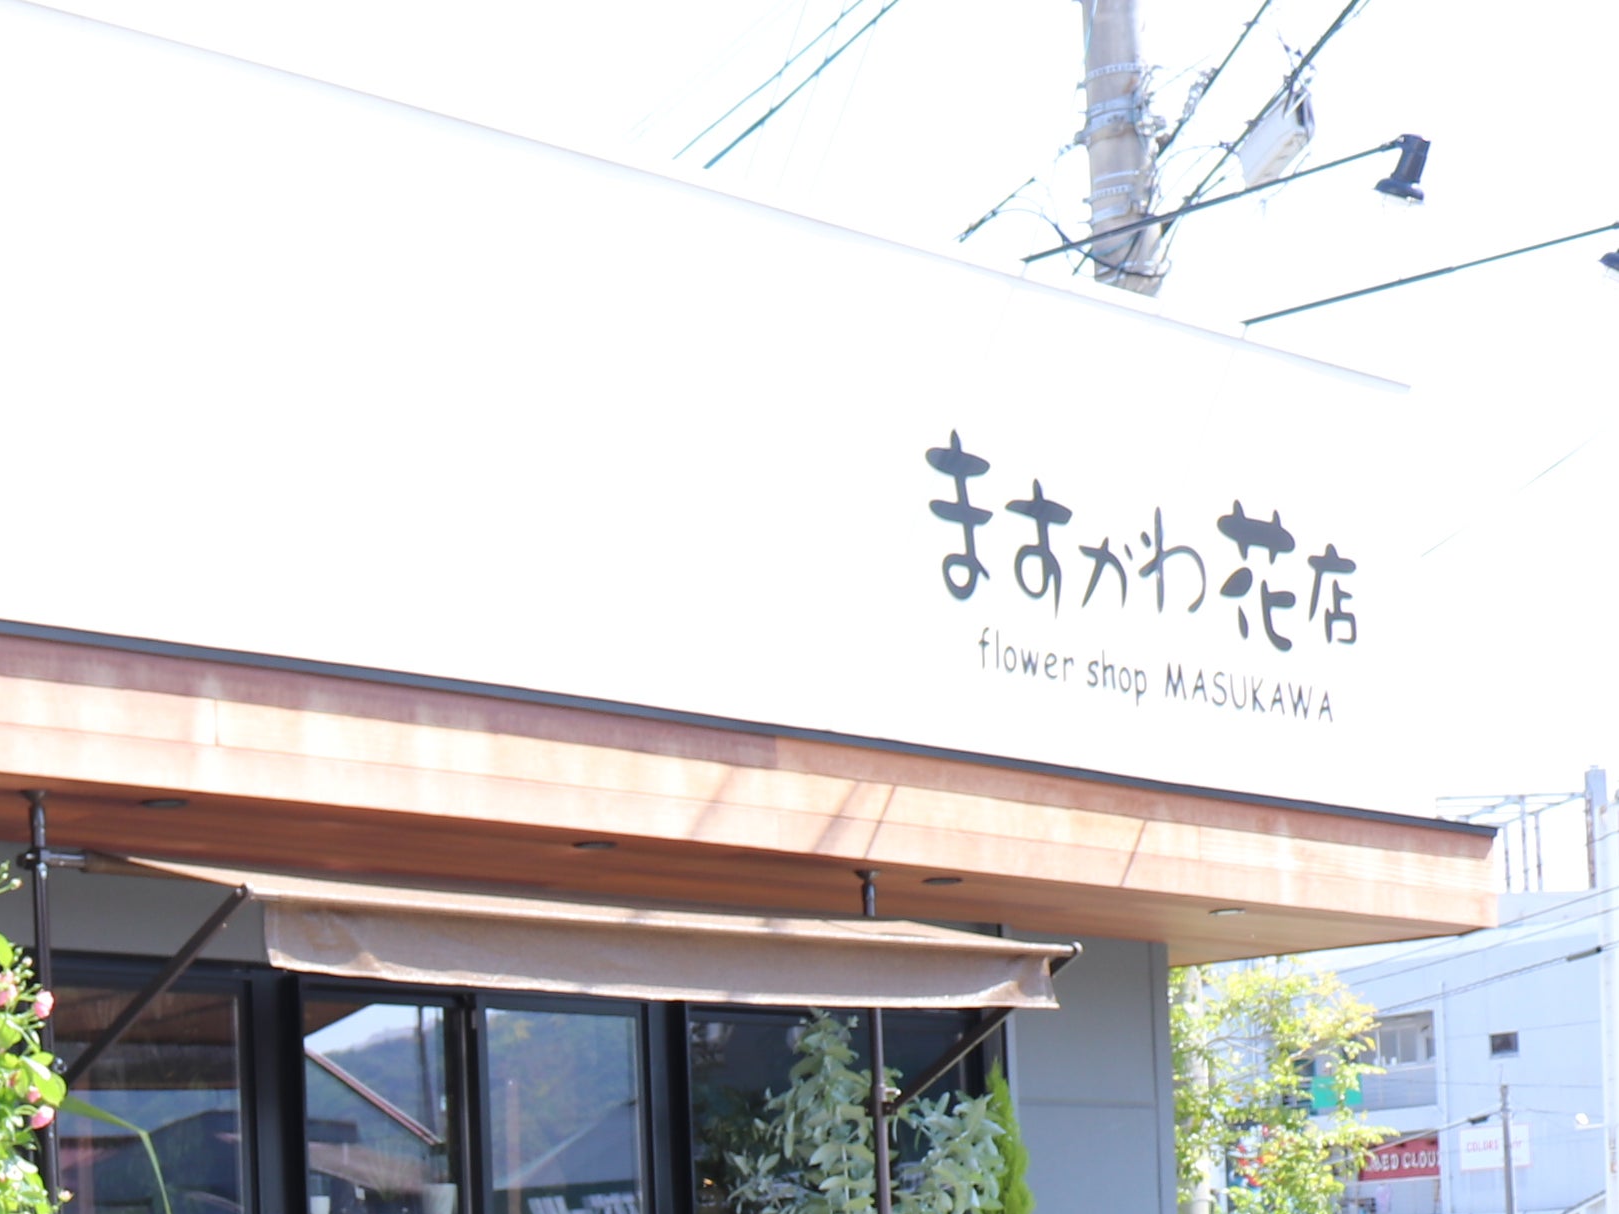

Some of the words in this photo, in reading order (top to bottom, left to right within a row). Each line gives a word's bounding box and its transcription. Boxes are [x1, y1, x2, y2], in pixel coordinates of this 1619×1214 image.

[925, 429, 1357, 652] ますかわ花店
[979, 627, 1074, 681] flower
[1087, 650, 1148, 706] shop
[1165, 662, 1334, 723] MASUKAWA
